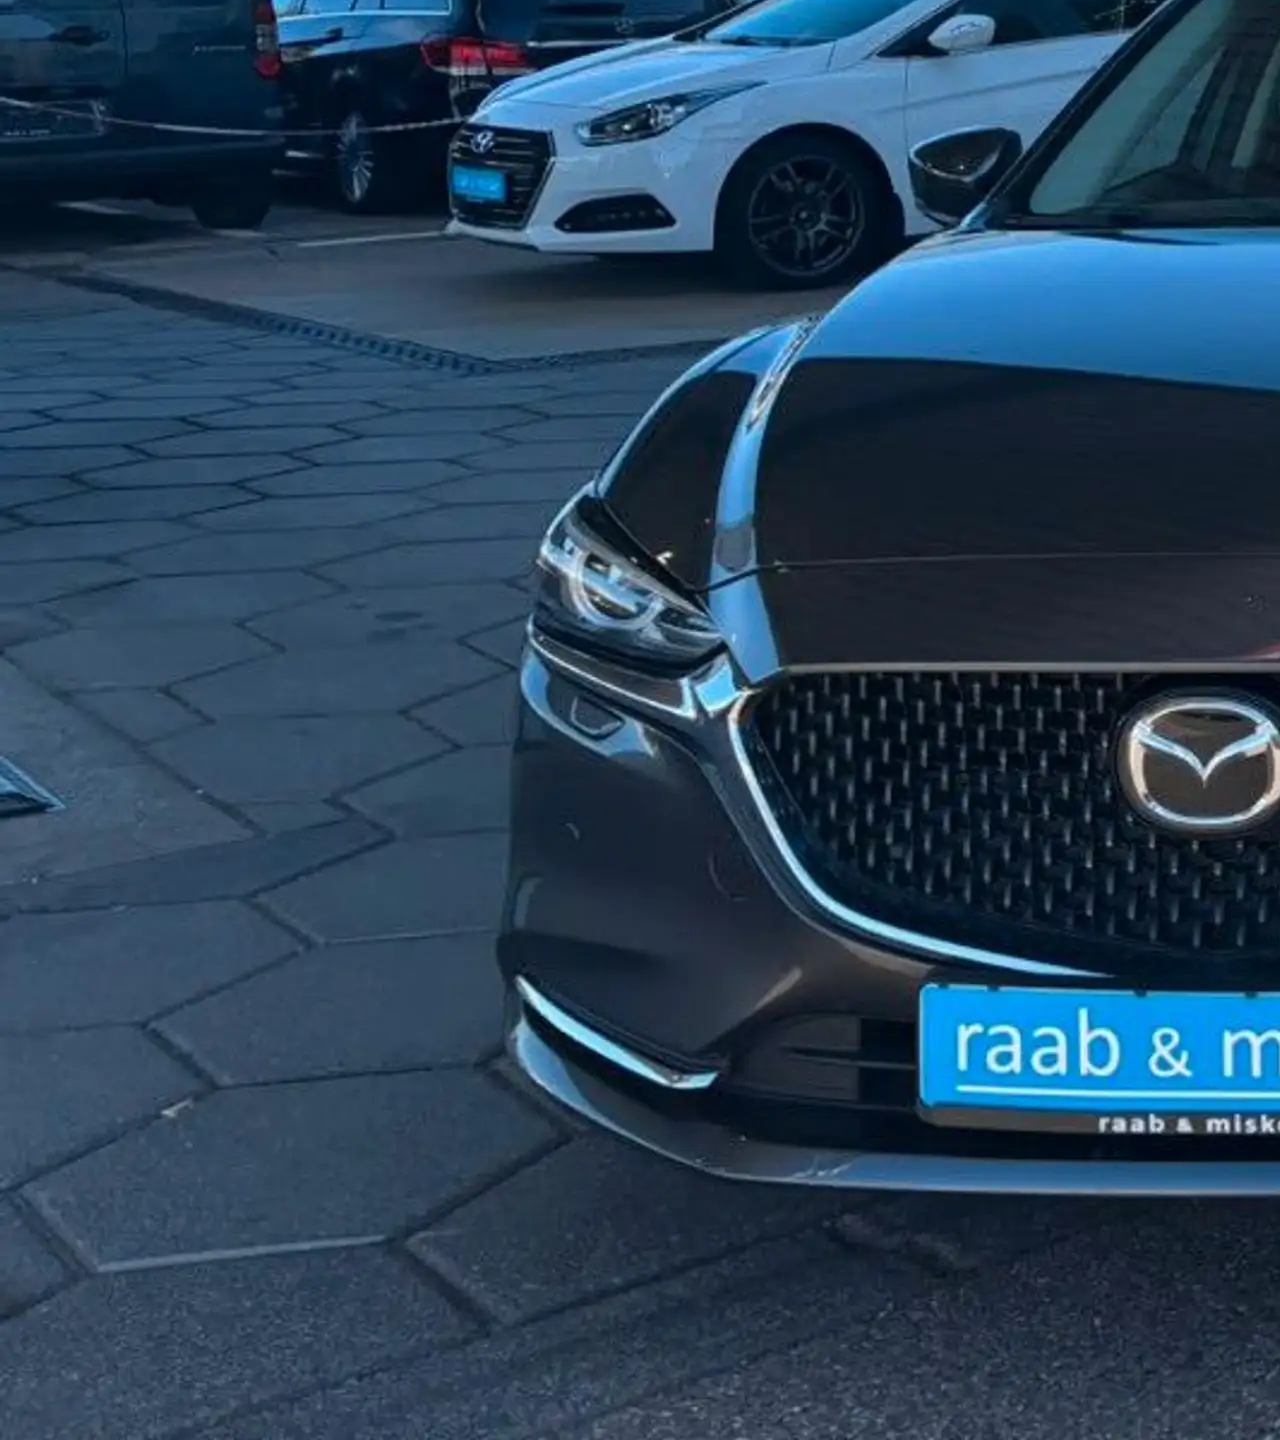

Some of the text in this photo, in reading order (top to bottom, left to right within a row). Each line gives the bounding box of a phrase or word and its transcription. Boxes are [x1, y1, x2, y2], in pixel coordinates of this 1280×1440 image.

[956, 1007, 1121, 1079] raab
[1148, 1026, 1193, 1079] &
[1098, 1113, 1166, 1135] raab
